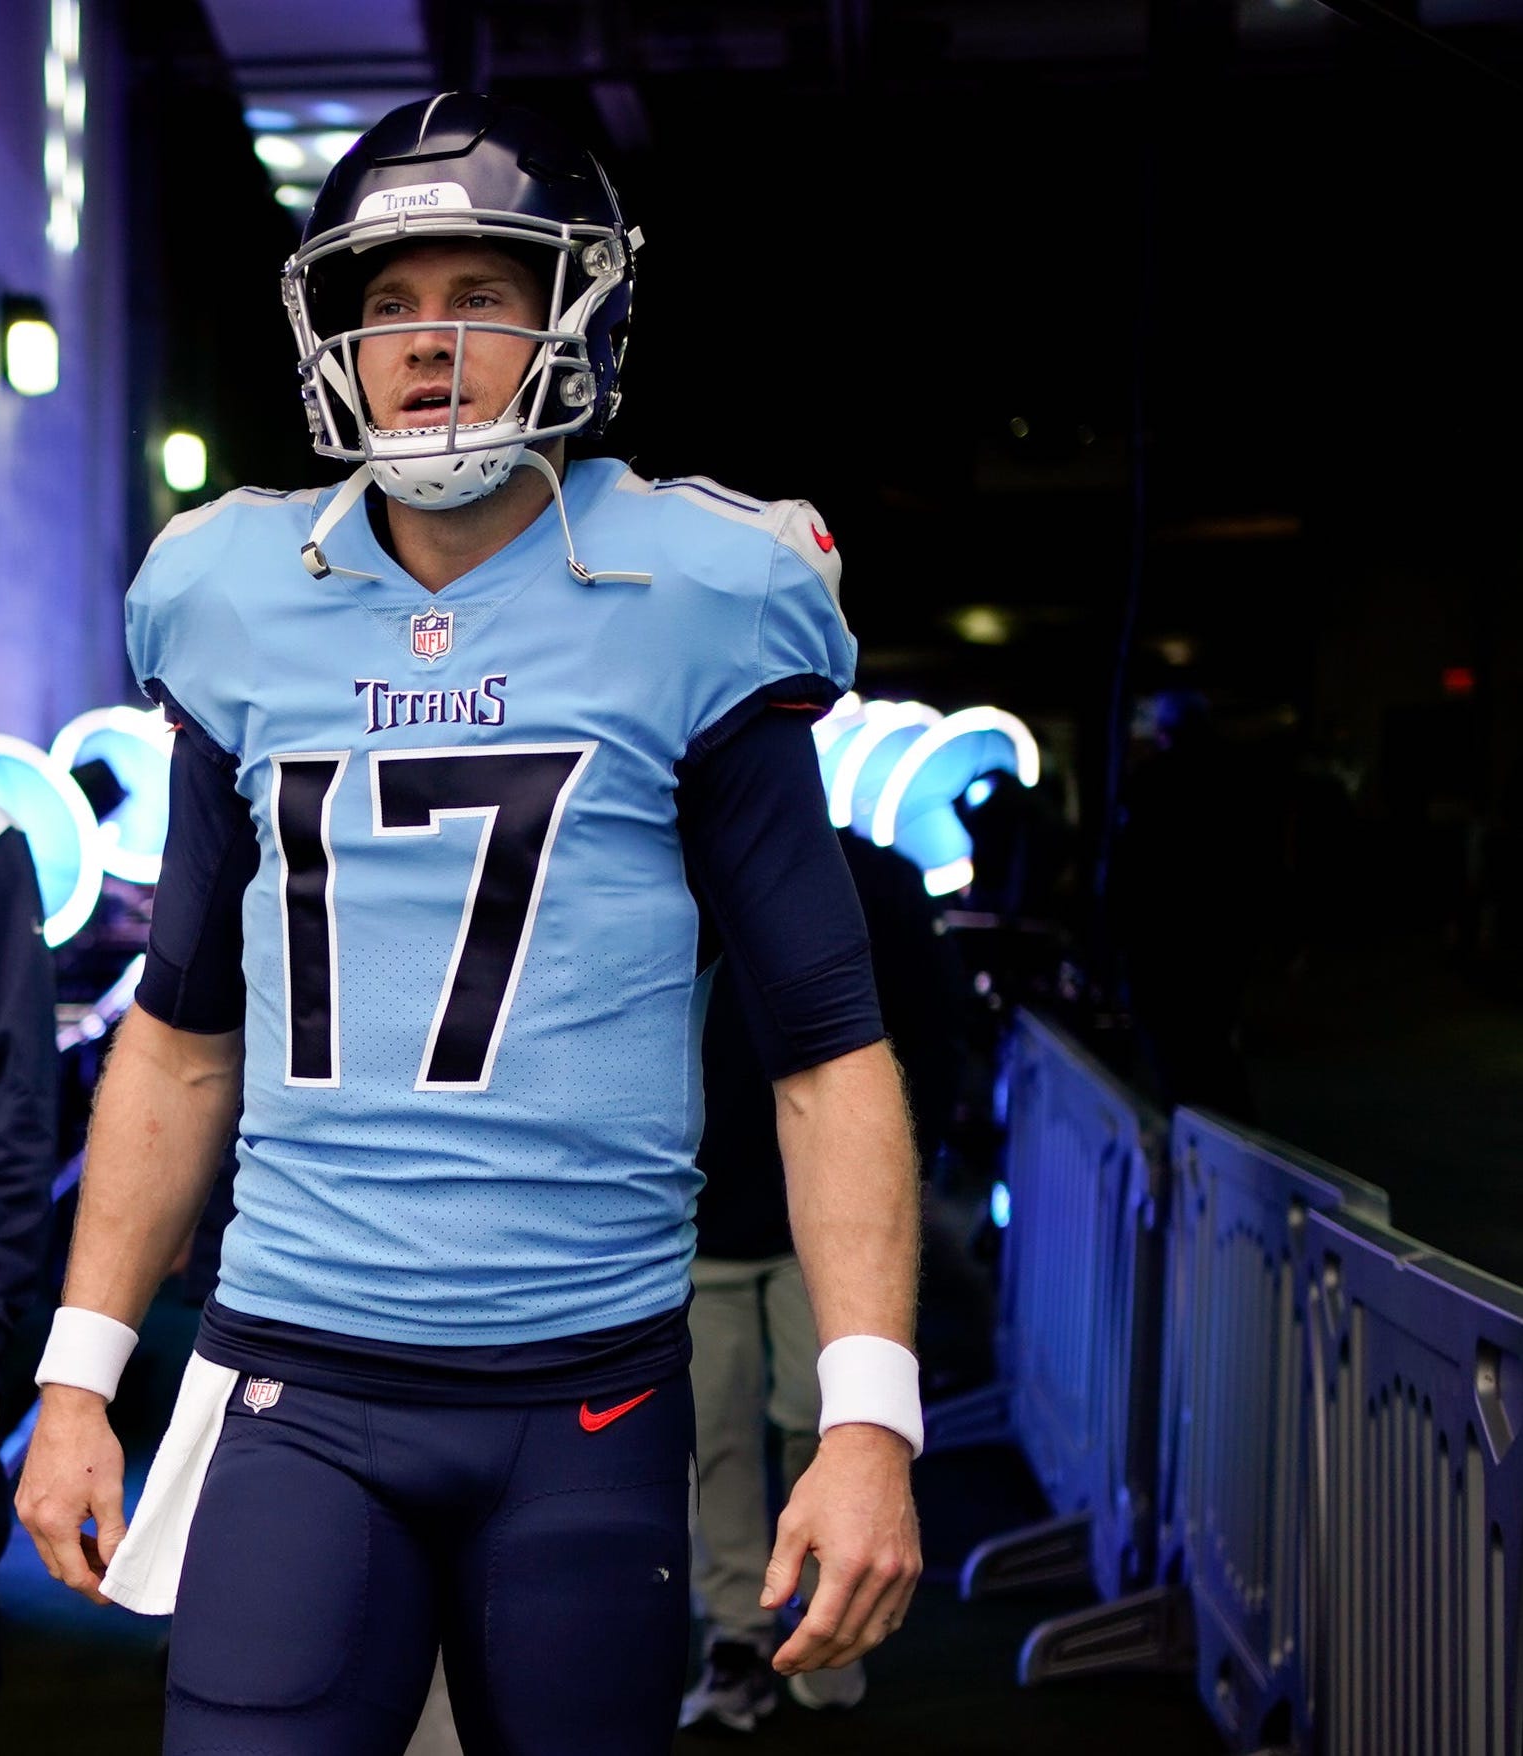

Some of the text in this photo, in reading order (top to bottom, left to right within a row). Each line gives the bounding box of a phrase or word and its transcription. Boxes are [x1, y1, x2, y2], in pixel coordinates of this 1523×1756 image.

[382, 188, 439, 211] TITANS
[416, 631, 446, 653] NFL
[354, 673, 508, 735] TITANS
[269, 741, 600, 1092] 17
[249, 1384, 274, 1403] NFL
